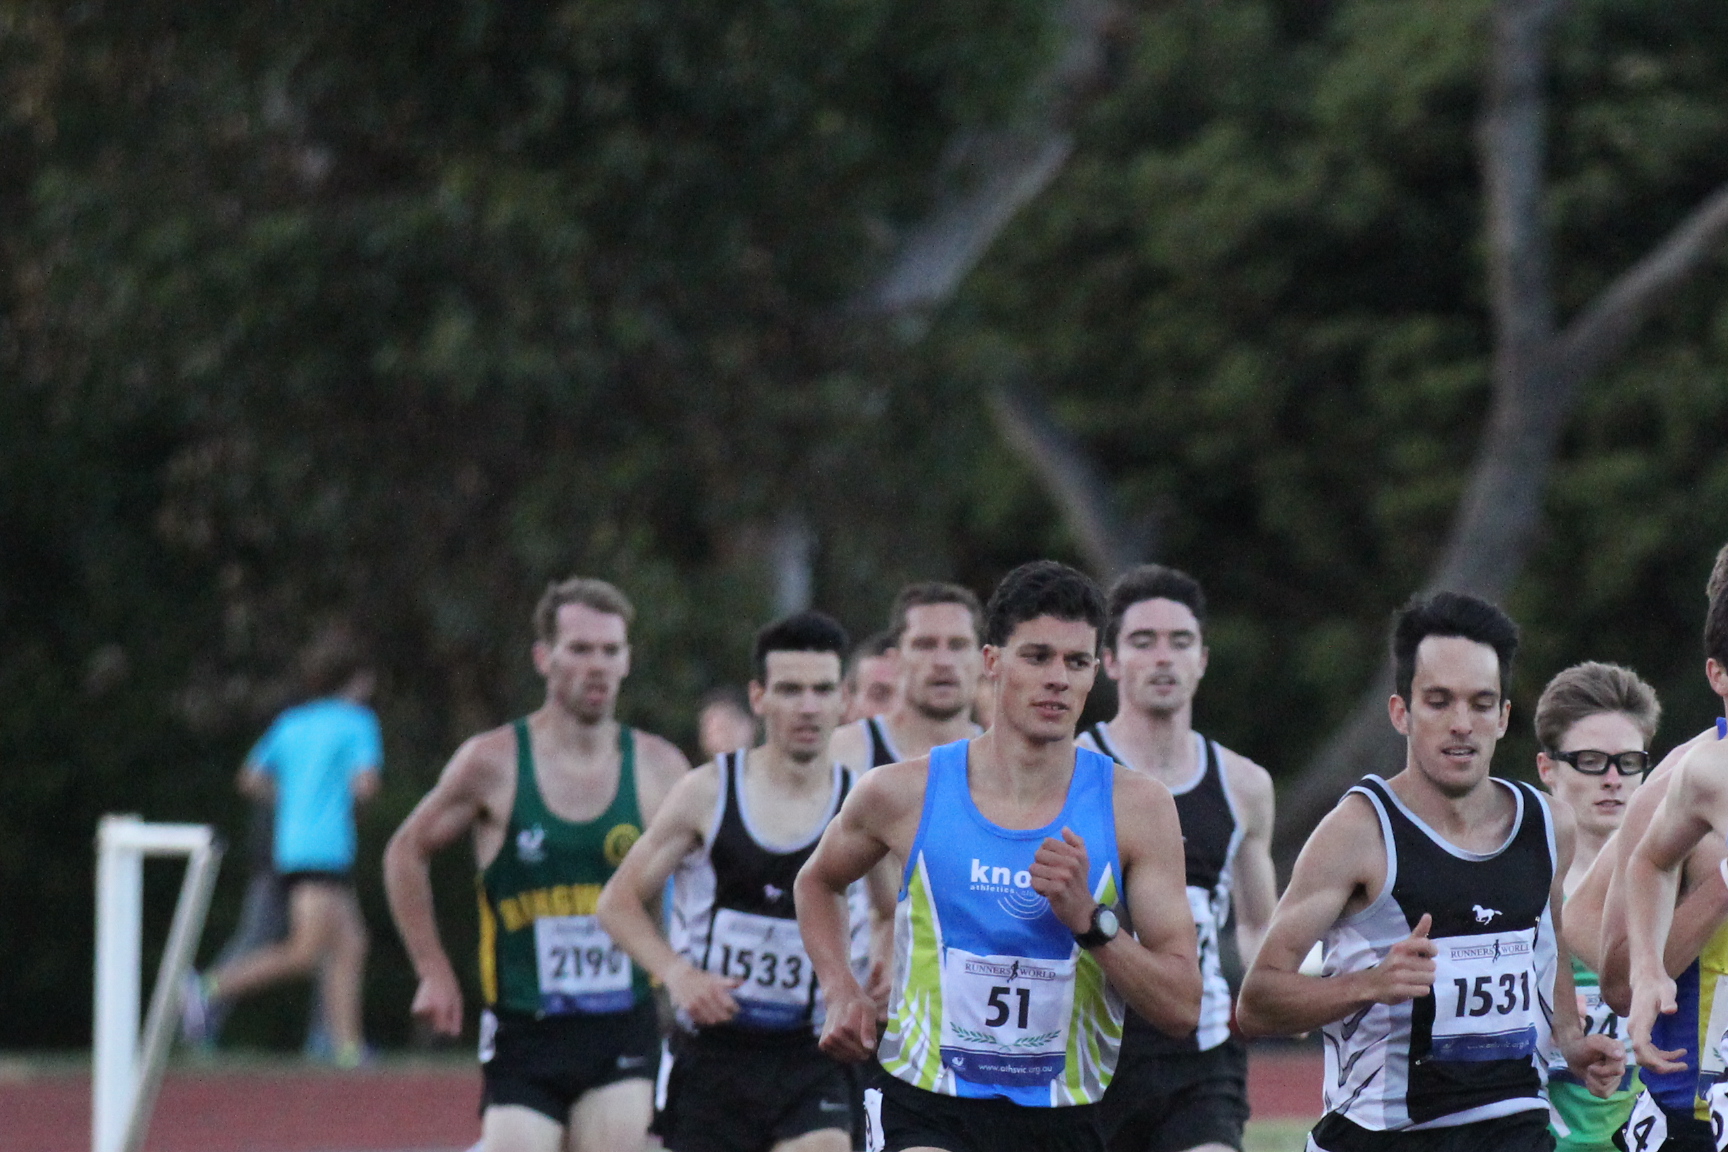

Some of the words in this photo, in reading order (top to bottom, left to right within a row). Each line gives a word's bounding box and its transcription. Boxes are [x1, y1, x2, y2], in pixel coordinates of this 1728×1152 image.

[722, 943, 802, 989] 1533
[1451, 948, 1494, 959] RUNNERS
[965, 963, 1012, 976] RUNNERS
[1020, 968, 1056, 979] WORLD
[985, 986, 1030, 1029] 51
[1454, 970, 1530, 1018] 1531
[978, 1063, 1053, 1074] www.athsvic.org.au
